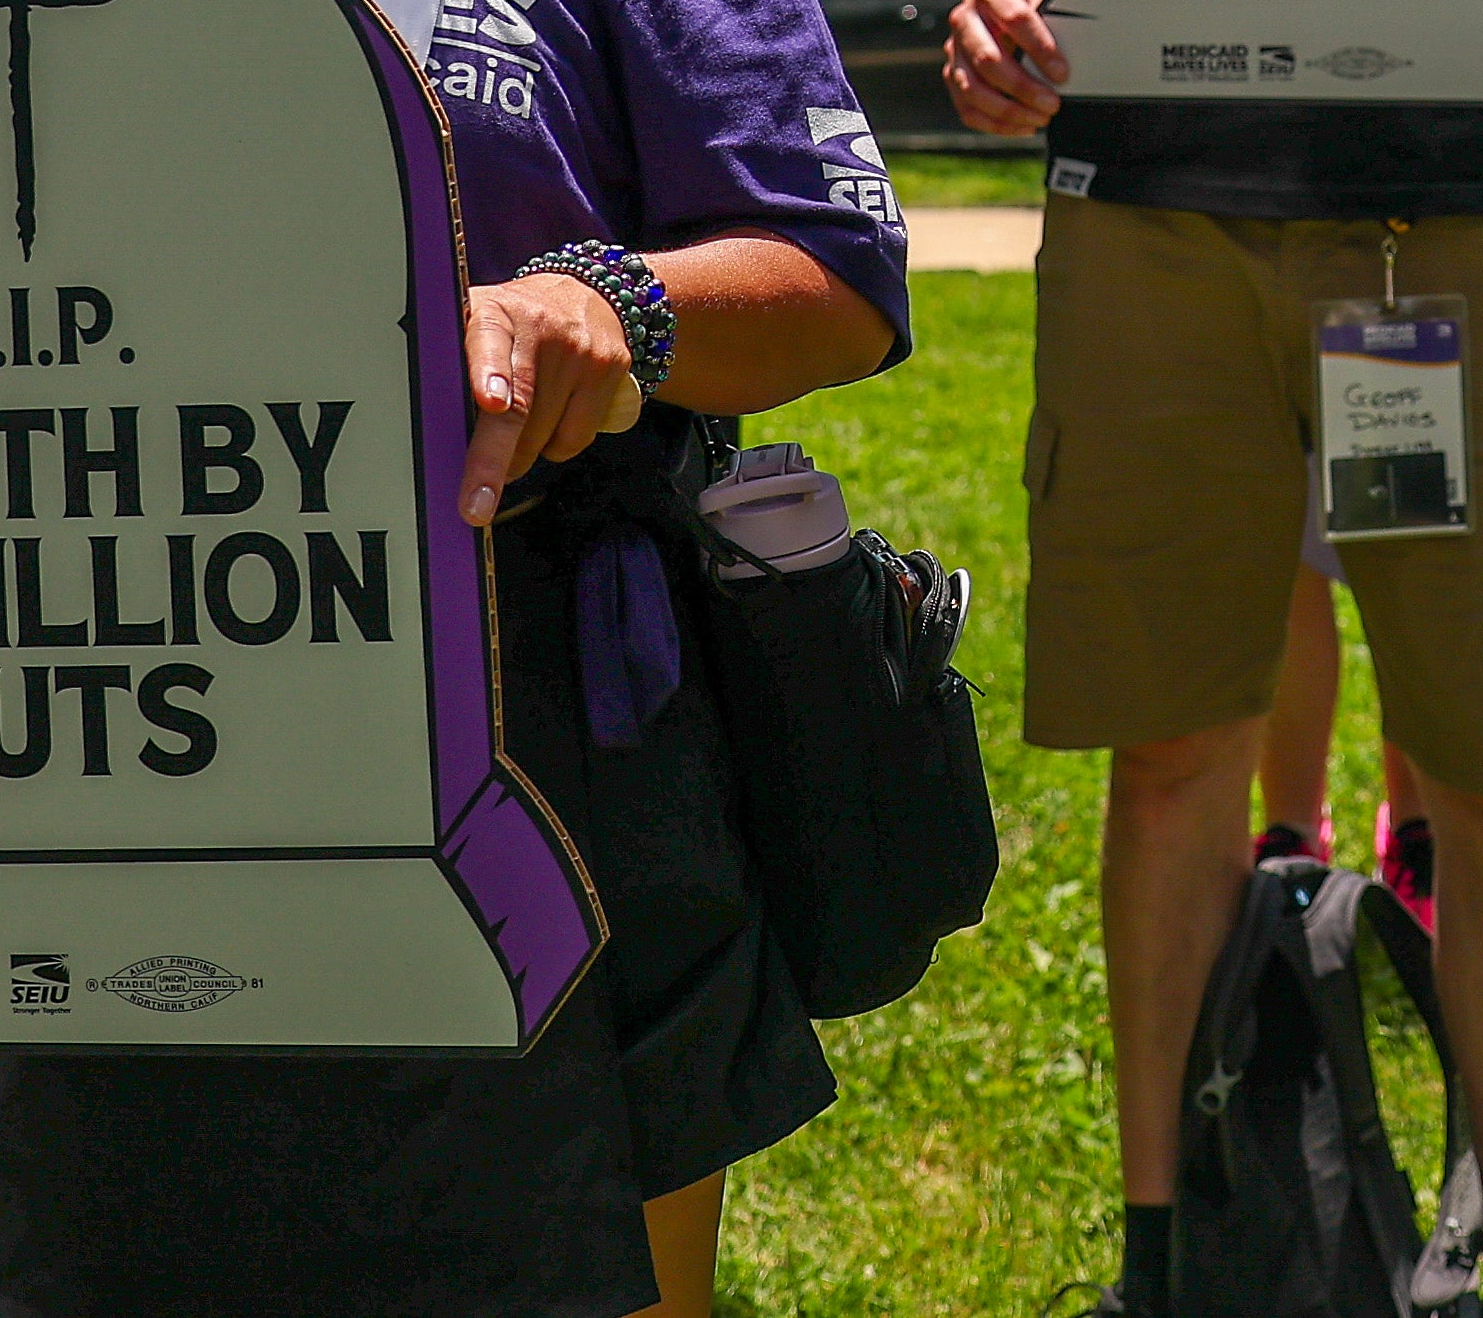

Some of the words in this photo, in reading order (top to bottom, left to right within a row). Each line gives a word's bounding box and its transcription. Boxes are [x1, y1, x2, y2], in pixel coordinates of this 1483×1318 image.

[1161, 44, 1249, 58] MEDICAID
[175, 399, 356, 517] BY
[129, 958, 164, 977] ALLIED
[169, 958, 217, 975] PRINTING
[110, 980, 153, 989] TRADES
[193, 980, 238, 989] COUNCIL
[158, 975, 187, 984] UNION
[251, 978, 264, 989] 81
[9, 985, 70, 1004] SEIU
[158, 984, 188, 993] LABEL
[129, 993, 185, 1011] NORTHERN
[190, 992, 220, 1010] CALIF
